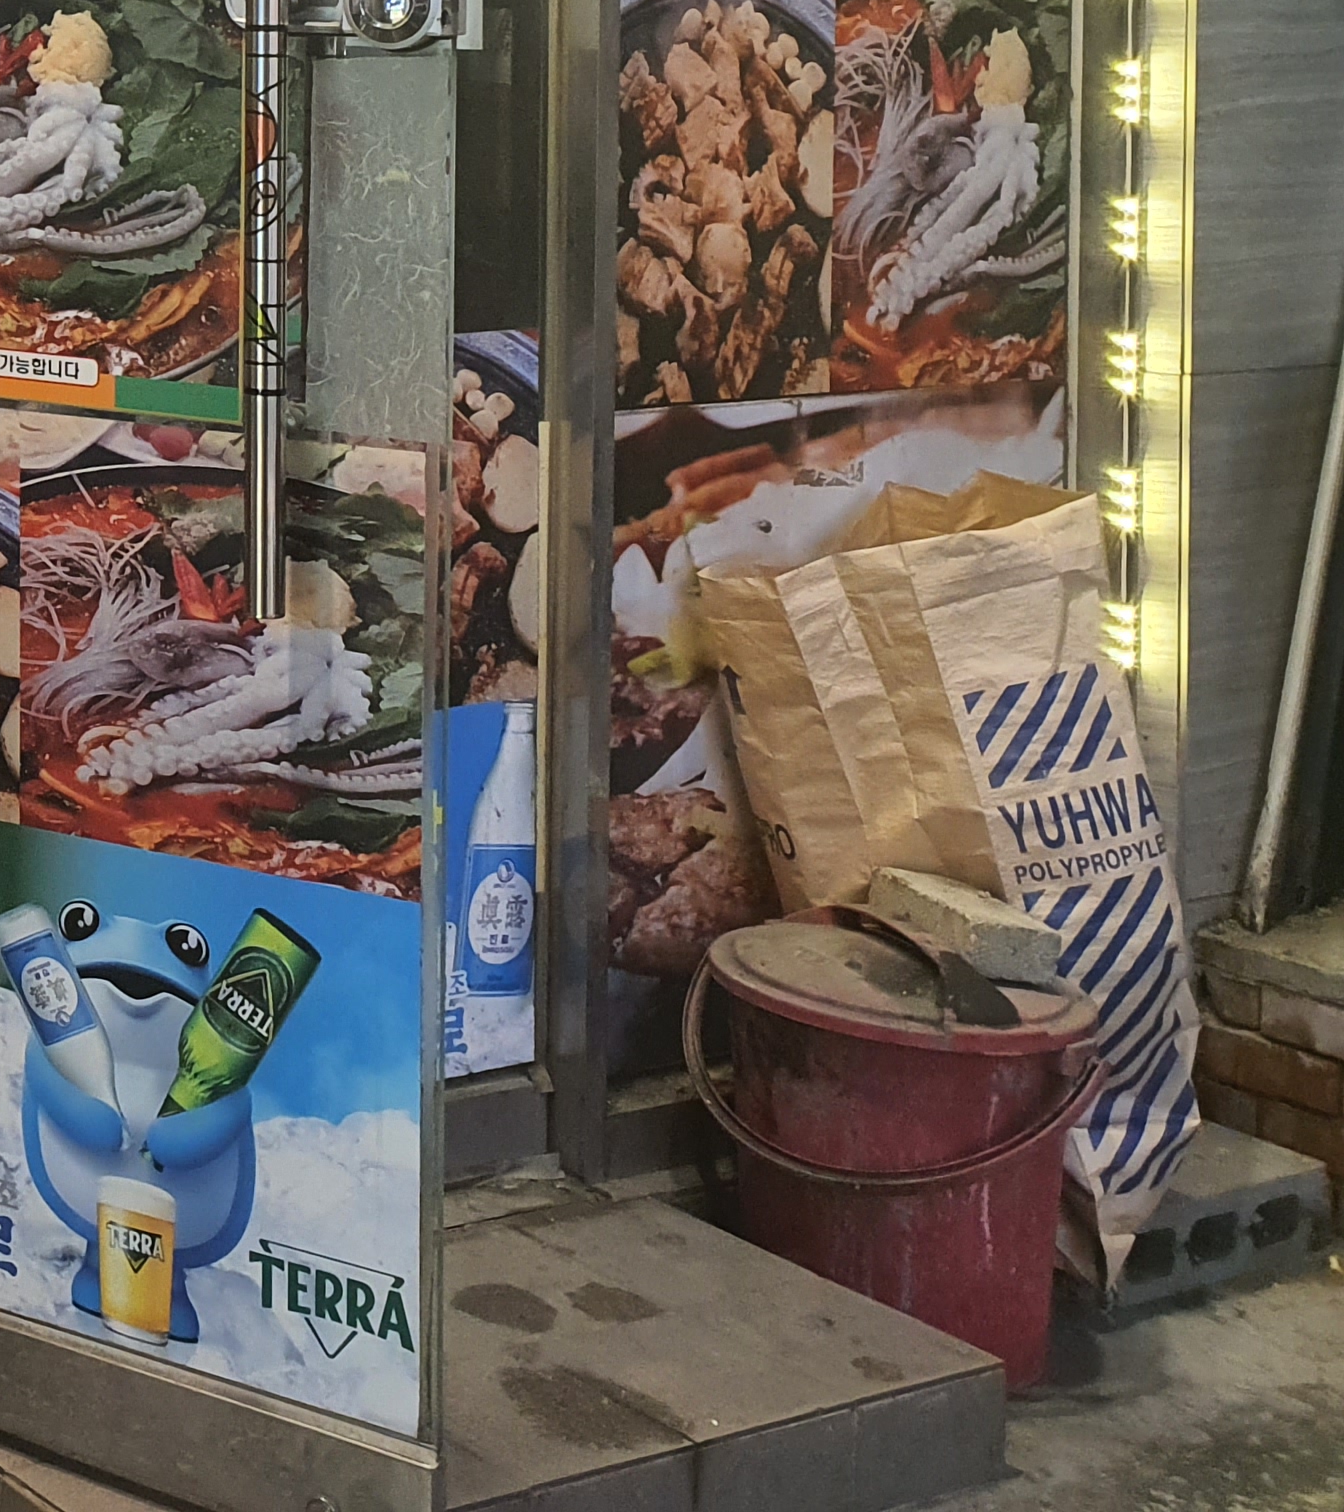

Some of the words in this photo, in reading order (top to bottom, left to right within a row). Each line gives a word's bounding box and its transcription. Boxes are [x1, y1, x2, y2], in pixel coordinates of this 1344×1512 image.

[0, 353, 80, 380] 가능합니다
[996, 772, 1162, 855] YUHWA
[216, 978, 276, 1040] TERRA
[105, 1219, 166, 1262] TERRA
[248, 1244, 415, 1354] TERRA
